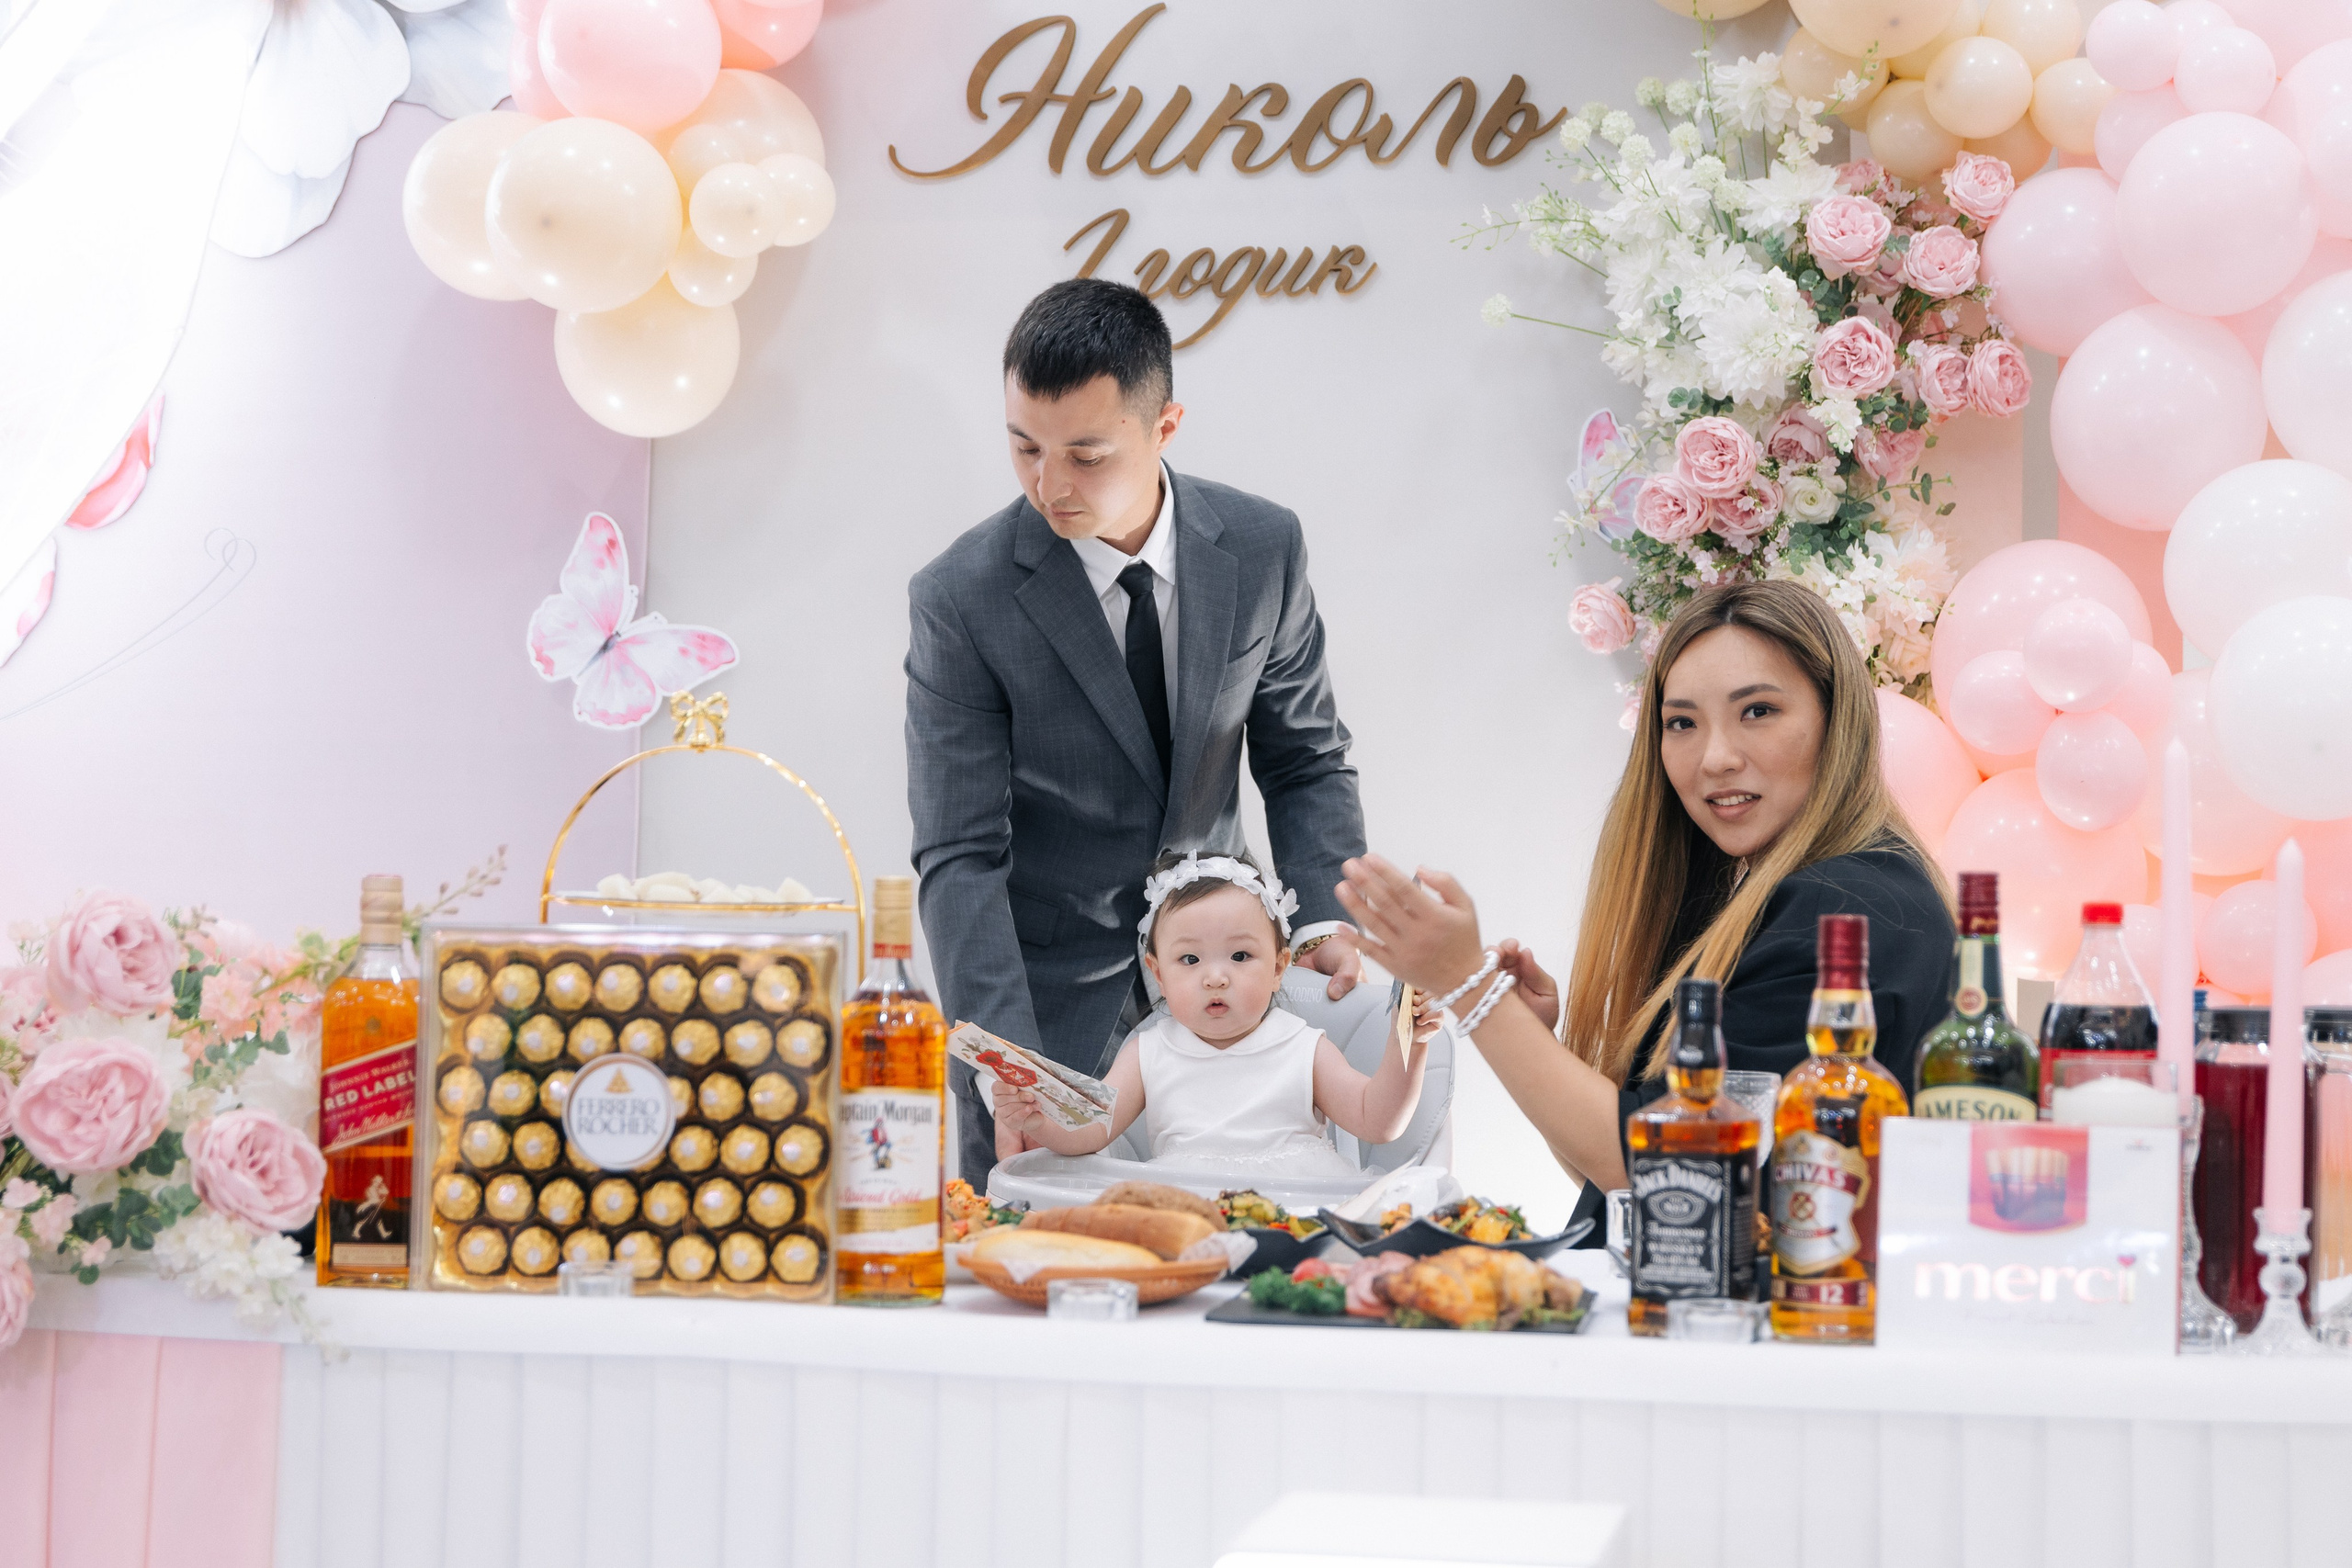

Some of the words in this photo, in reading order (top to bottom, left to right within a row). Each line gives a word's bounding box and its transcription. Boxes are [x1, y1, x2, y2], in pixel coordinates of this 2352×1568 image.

[888, 3, 1567, 178] Николь
[1063, 208, 1131, 279] 1
[1134, 244, 1379, 350] годик
[323, 1089, 359, 1111] RED
[361, 1069, 416, 1099] LABEL
[578, 1097, 660, 1115] FERRERO
[838, 1101, 876, 1125] aptain
[578, 1116, 659, 1134] ROCHER
[1775, 1163, 1847, 1189] CHIVAS
[1914, 1254, 2137, 1304] merci
[1819, 1283, 1845, 1304] 12
